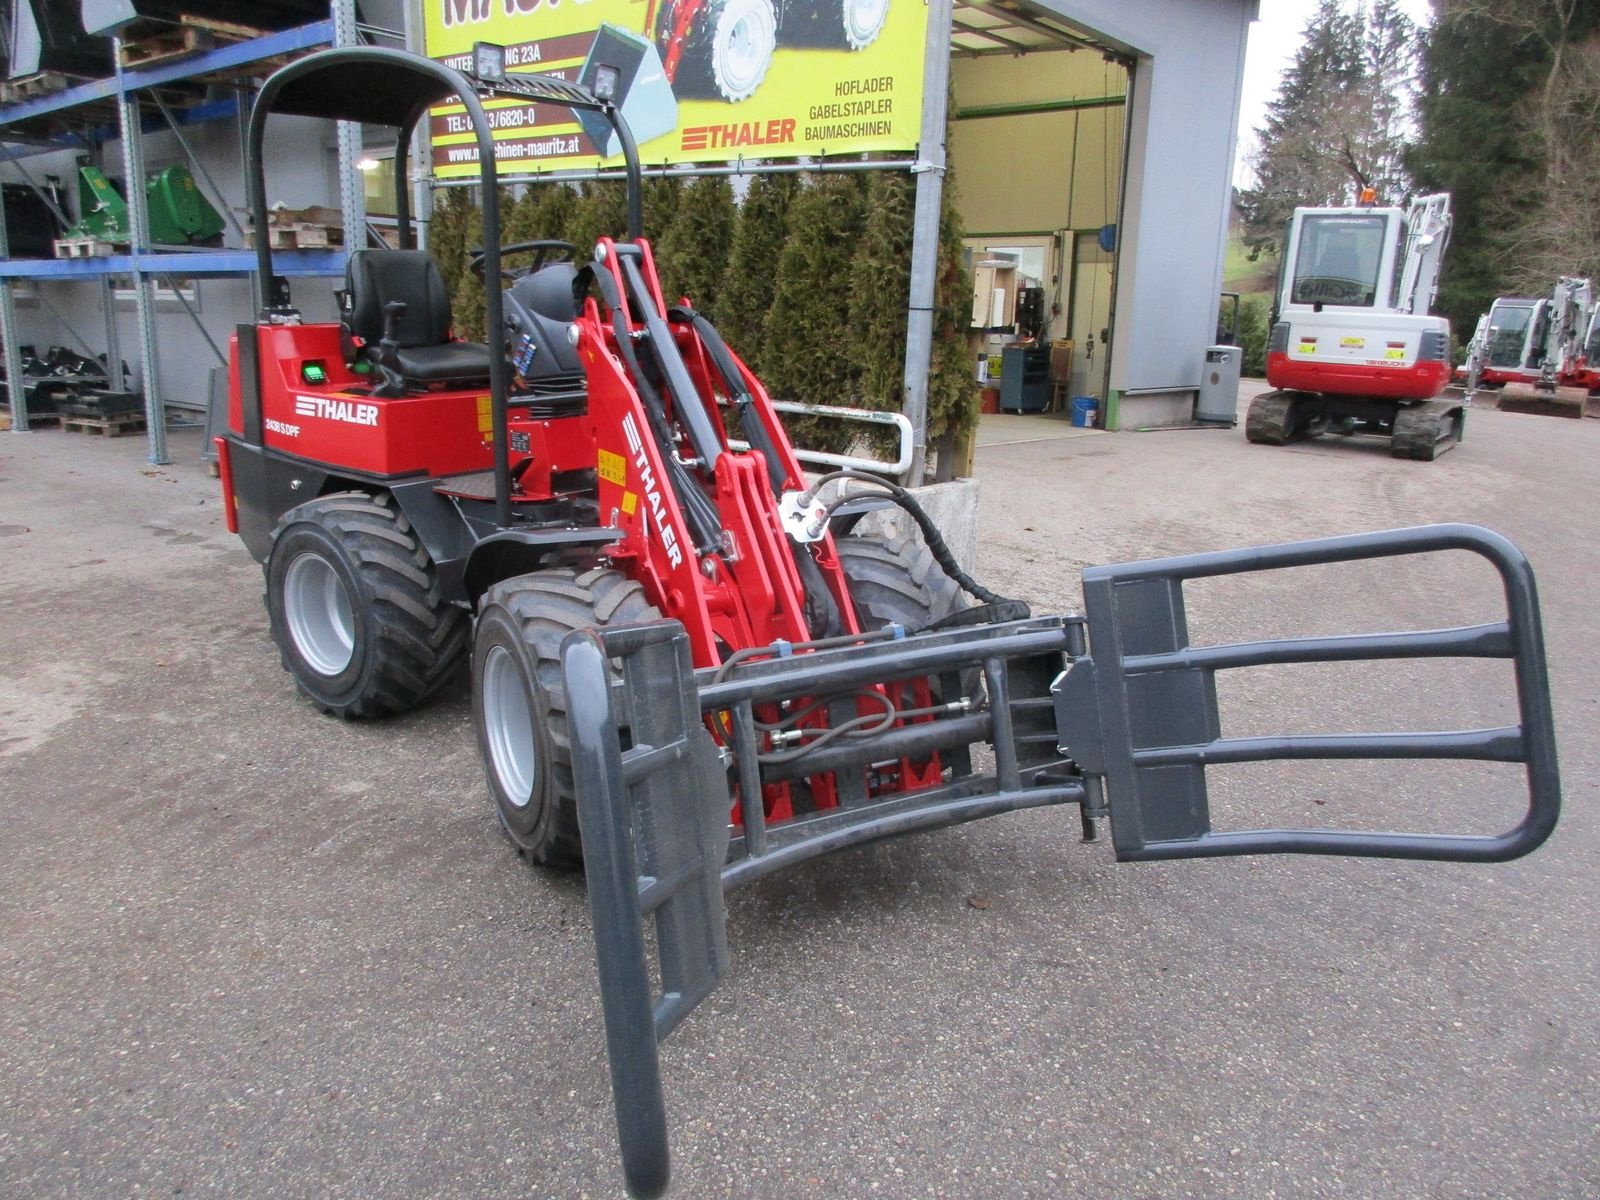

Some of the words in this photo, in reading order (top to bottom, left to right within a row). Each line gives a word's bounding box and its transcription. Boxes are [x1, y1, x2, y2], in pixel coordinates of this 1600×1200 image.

[521, 44, 541, 63] 23A
[835, 76, 894, 97] HOFLADER
[809, 98, 893, 120] GABELSTAPLER
[447, 116, 466, 133] TEL:
[707, 118, 796, 149] THALER
[805, 120, 892, 142] BAUMASCHINEN
[315, 398, 379, 427] THALER
[636, 445, 683, 570] THALER
